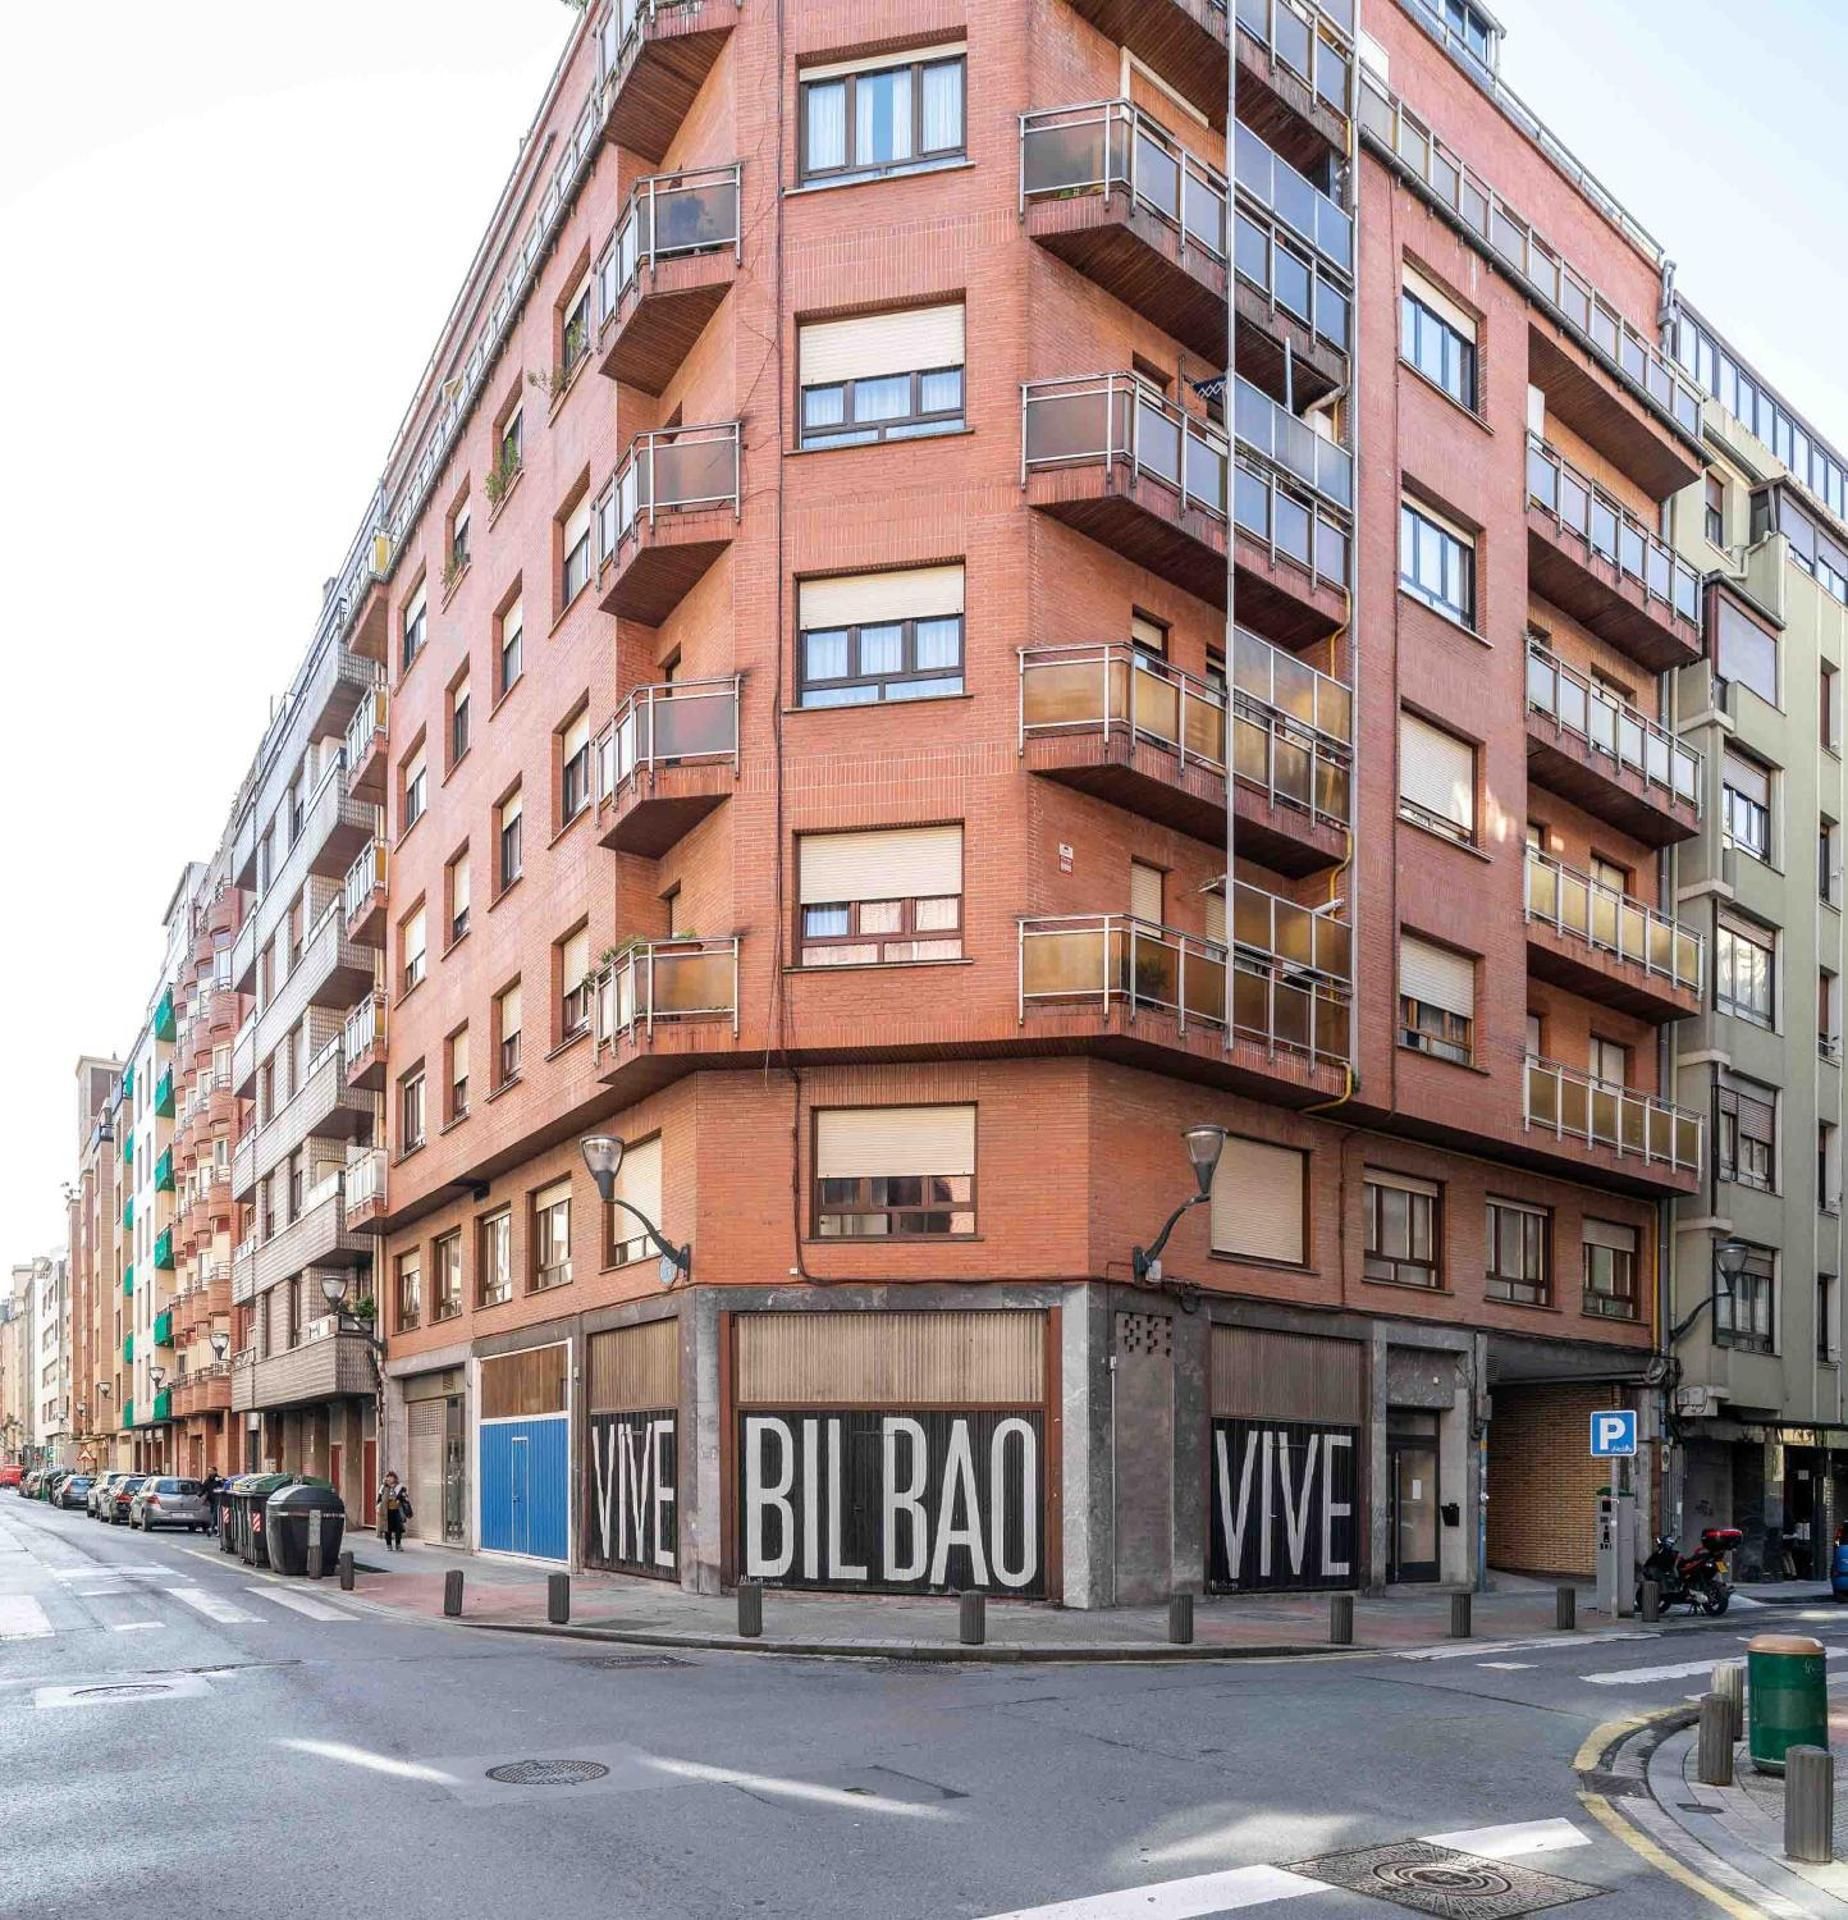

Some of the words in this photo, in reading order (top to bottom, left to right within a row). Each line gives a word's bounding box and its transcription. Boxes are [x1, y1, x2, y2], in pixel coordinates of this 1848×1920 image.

[592, 1420, 674, 1567] VIVE
[745, 1416, 1038, 1588] BILBAO
[1215, 1430, 1352, 1579] VIVE
[1599, 1417, 1626, 1450] P
